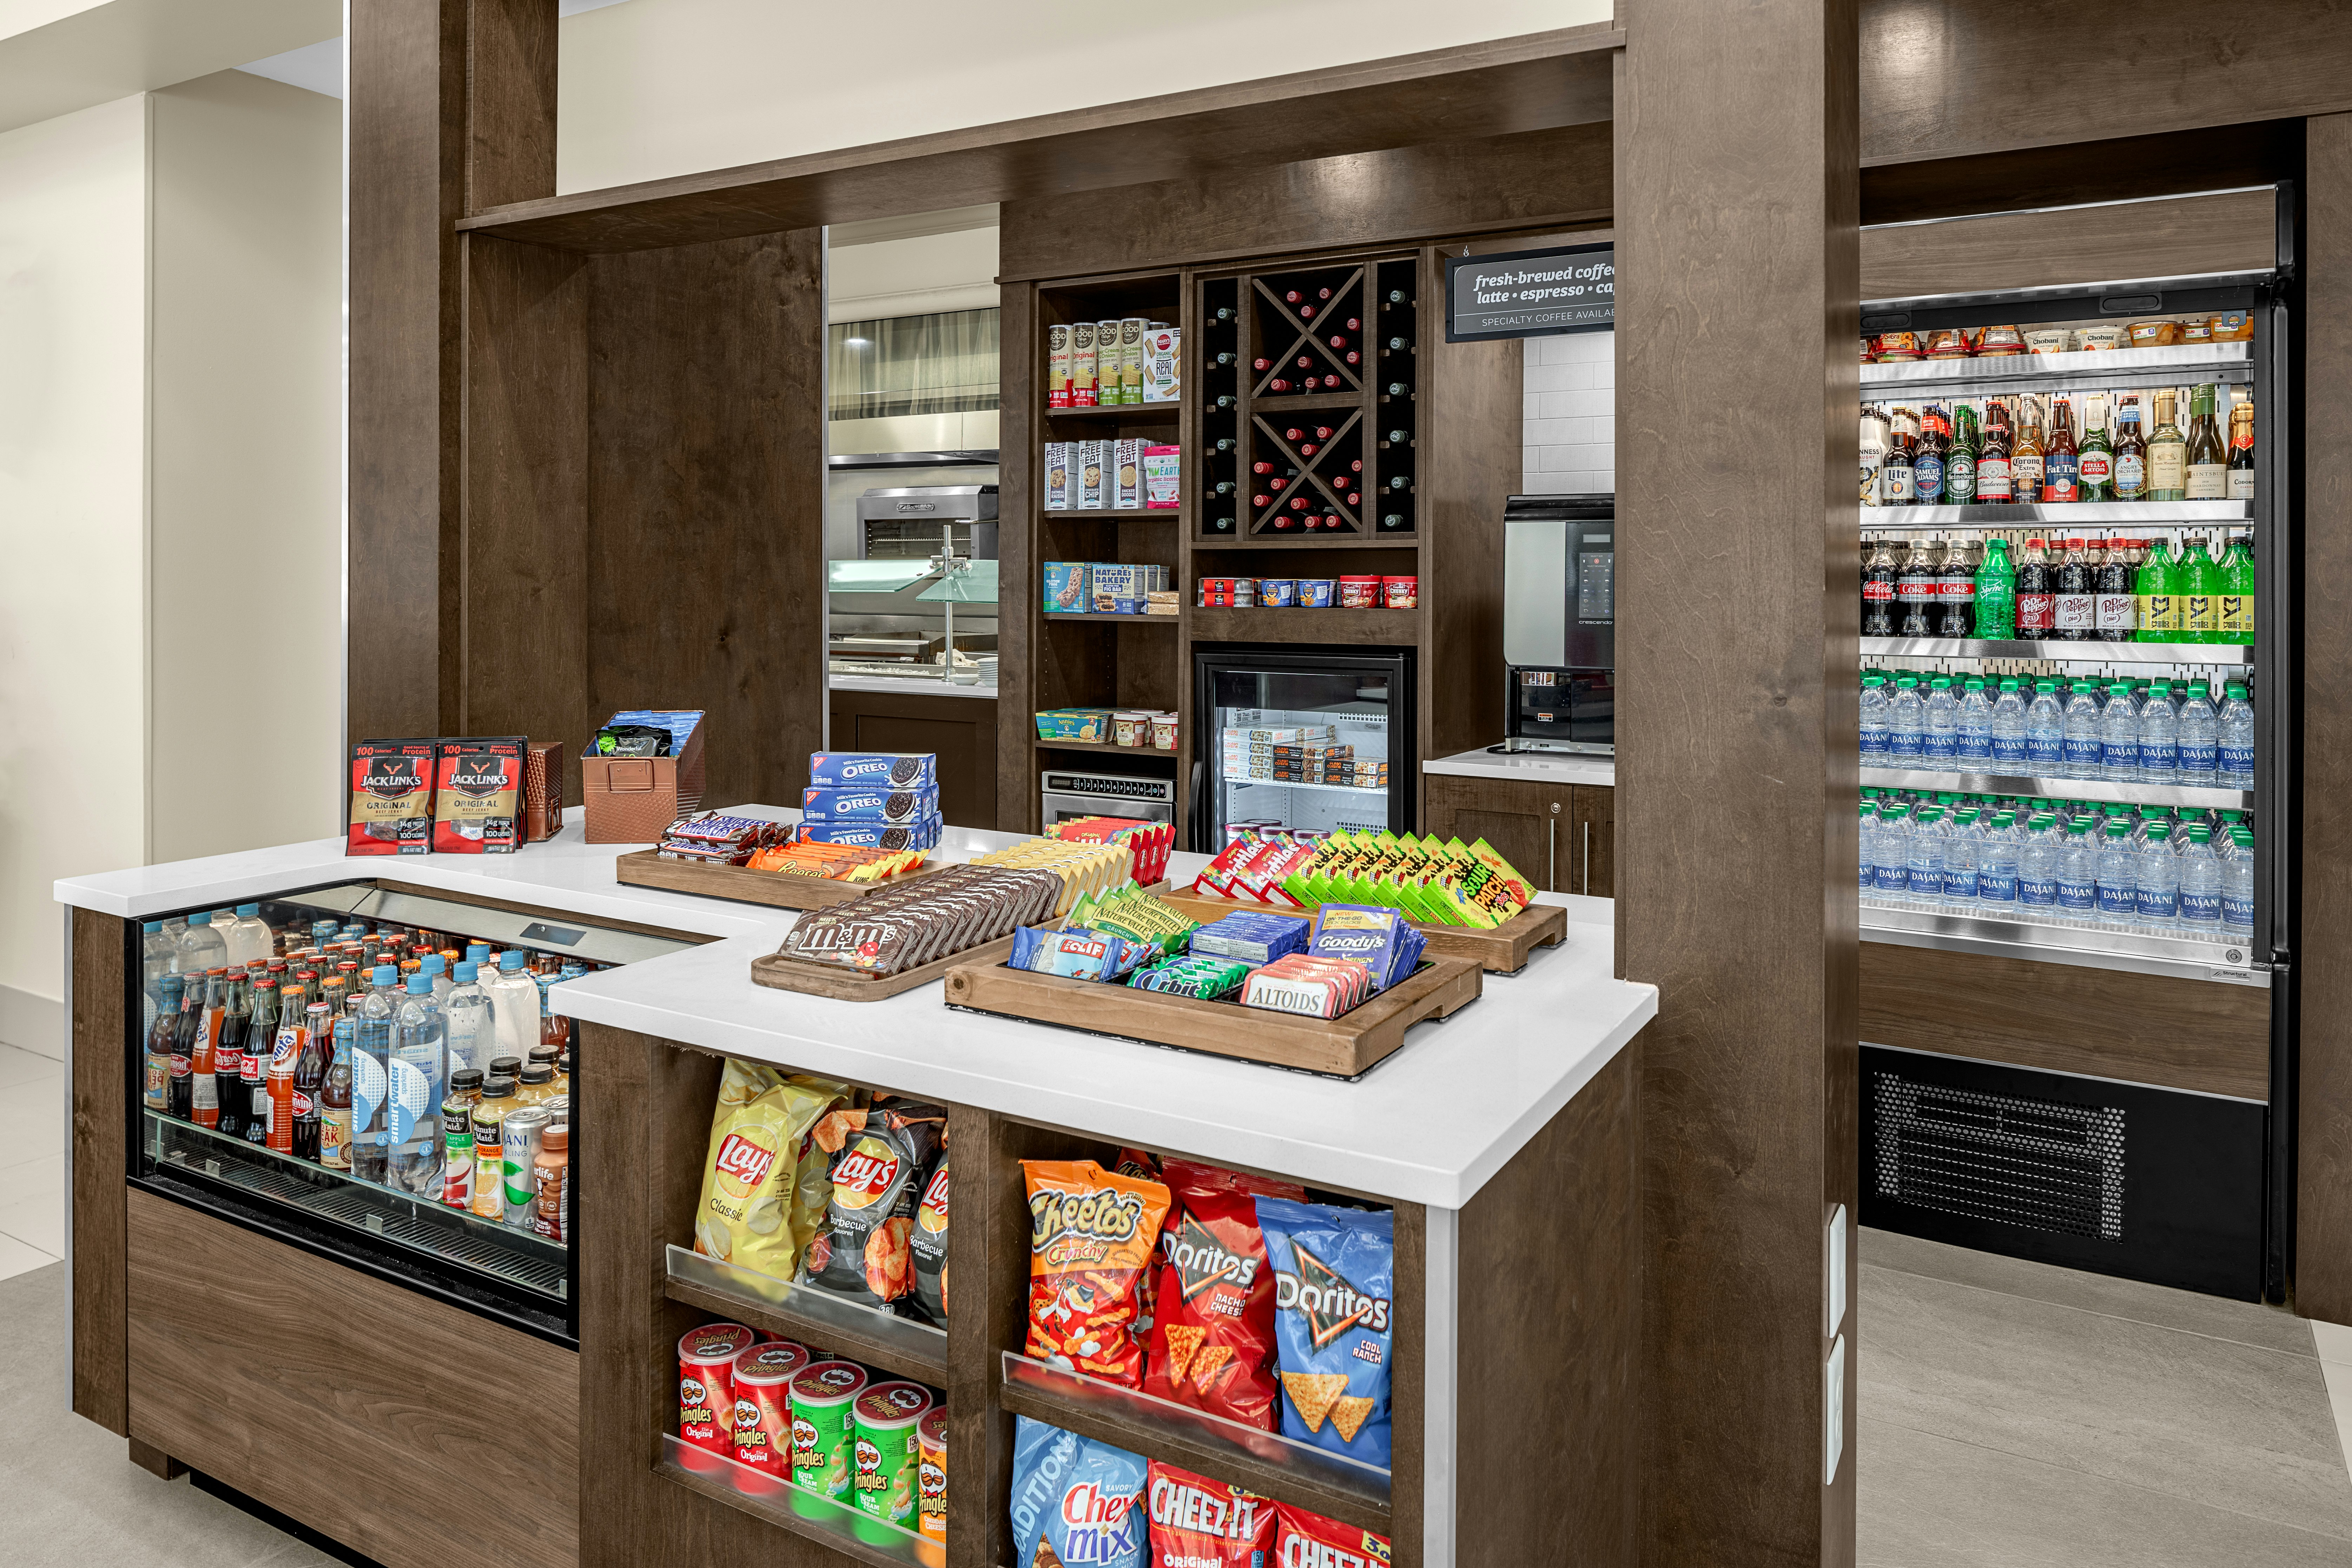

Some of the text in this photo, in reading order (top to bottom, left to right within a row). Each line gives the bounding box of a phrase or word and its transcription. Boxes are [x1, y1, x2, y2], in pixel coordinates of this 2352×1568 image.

[1473, 267, 1572, 291] fresh-brewed
[1477, 283, 1614, 304] latte espresso ca
[1482, 315, 1532, 326] SPECIALTY
[1536, 312, 1572, 322] COFFEE
[1081, 444, 1101, 457] FREE
[2013, 458, 2040, 467] Corona
[2047, 465, 2077, 474] Fat Tire
[1888, 470, 1907, 481] Lite
[1863, 581, 1895, 593] Coca-Cola
[1902, 584, 1926, 594] Coke
[1980, 584, 2003, 593] Sprite
[2064, 600, 2089, 613] Pepper
[1892, 733, 1920, 746] DASANI
[2029, 739, 2059, 752] DASANI
[2067, 739, 2097, 752] DASANI
[357, 747, 374, 755] 100
[841, 763, 888, 778] OREO
[361, 775, 422, 786] JACK LINK'S
[679, 822, 734, 837] SNICKERS
[777, 861, 826, 878] Reese's
[1461, 863, 1492, 896] SOUR
[1474, 874, 1507, 911] PATCH
[1495, 892, 1510, 907] Kids
[2061, 886, 2093, 898] DASANI
[2185, 897, 2220, 908] DASANI
[1142, 895, 1195, 927] NATURE VALLEY
[1107, 925, 1134, 939] CRUNCHY
[1069, 942, 1103, 956] CLIF
[1318, 936, 1386, 951] Goody's
[1142, 973, 1201, 997] Orbit
[1252, 987, 1320, 1011] ALTOIDS
[390, 1063, 399, 1144] smartwater
[476, 1133, 493, 1142] Maid
[716, 1136, 775, 1184] Lay's
[832, 1153, 896, 1193] Lay's
[710, 1198, 743, 1222] Classic
[830, 1214, 866, 1232] Barbecue
[1030, 1189, 1137, 1248] Cheetos
[1047, 1244, 1108, 1264] Crunchy
[1163, 1232, 1261, 1286] Doritos
[1215, 1294, 1246, 1308] NACHO
[1276, 1273, 1390, 1329] Doritos
[1210, 1301, 1244, 1317] CHEESE
[1360, 1339, 1381, 1355] COOL
[1353, 1349, 1382, 1364] RANCH
[742, 1363, 791, 1374] Pringles
[680, 1405, 712, 1426] Pringles
[686, 1428, 713, 1438] Original
[792, 1448, 825, 1470] Pringles
[797, 1470, 813, 1480] SOUR
[798, 1475, 818, 1488] CREAM
[1063, 1482, 1139, 1525] Chex
[1151, 1478, 1260, 1539] CHEEZ-IT
[1068, 1524, 1136, 1565] mix
[1254, 1552, 1263, 1562] 150
